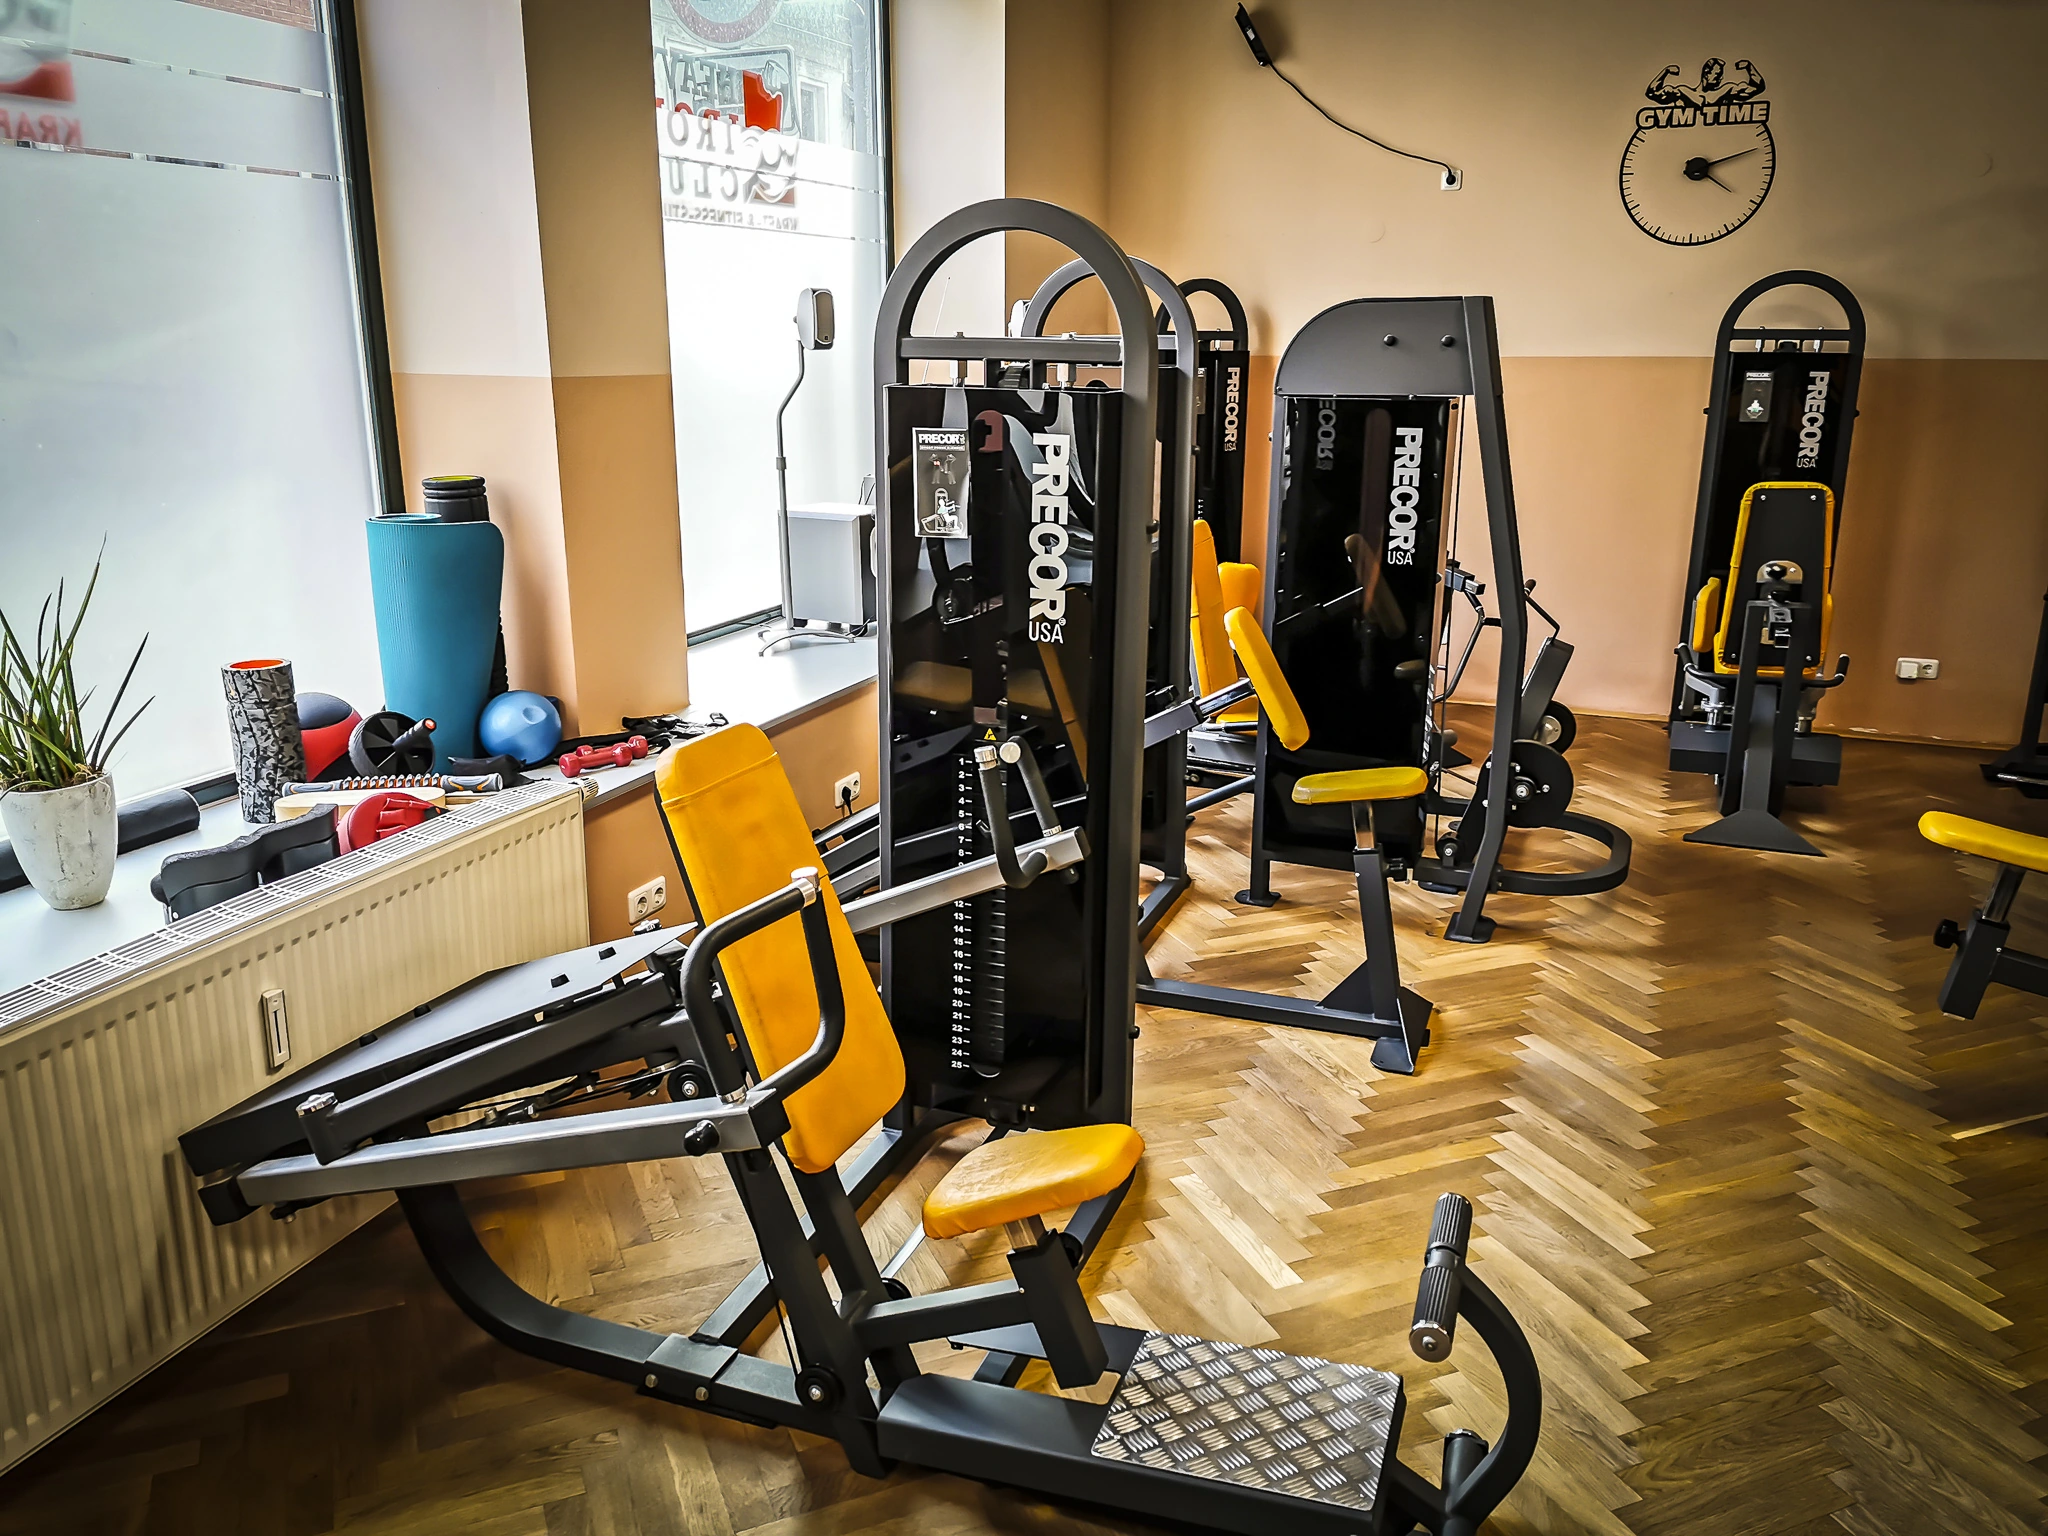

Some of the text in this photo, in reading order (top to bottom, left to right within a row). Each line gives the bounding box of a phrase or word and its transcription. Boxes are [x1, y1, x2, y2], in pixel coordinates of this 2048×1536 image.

[1637, 103, 1769, 128] GYM TIME
[1224, 367, 1240, 442] PRECOR
[1798, 371, 1830, 457] PRECOR
[918, 433, 960, 444] PRECOR
[1224, 442, 1237, 452] USA
[1796, 458, 1816, 468] USA
[1388, 427, 1423, 550] PRECOR
[1028, 433, 1070, 621] PRECOR
[1387, 550, 1413, 565] USA
[1028, 621, 1064, 644] USA
[954, 925, 964, 933] 14
[953, 950, 964, 958] 16
[953, 975, 963, 983] 18
[953, 987, 963, 995] 19
[952, 1012, 963, 1020] 21
[952, 1024, 963, 1032] 22
[952, 1036, 963, 1044] 23
[951, 1048, 962, 1056] 24
